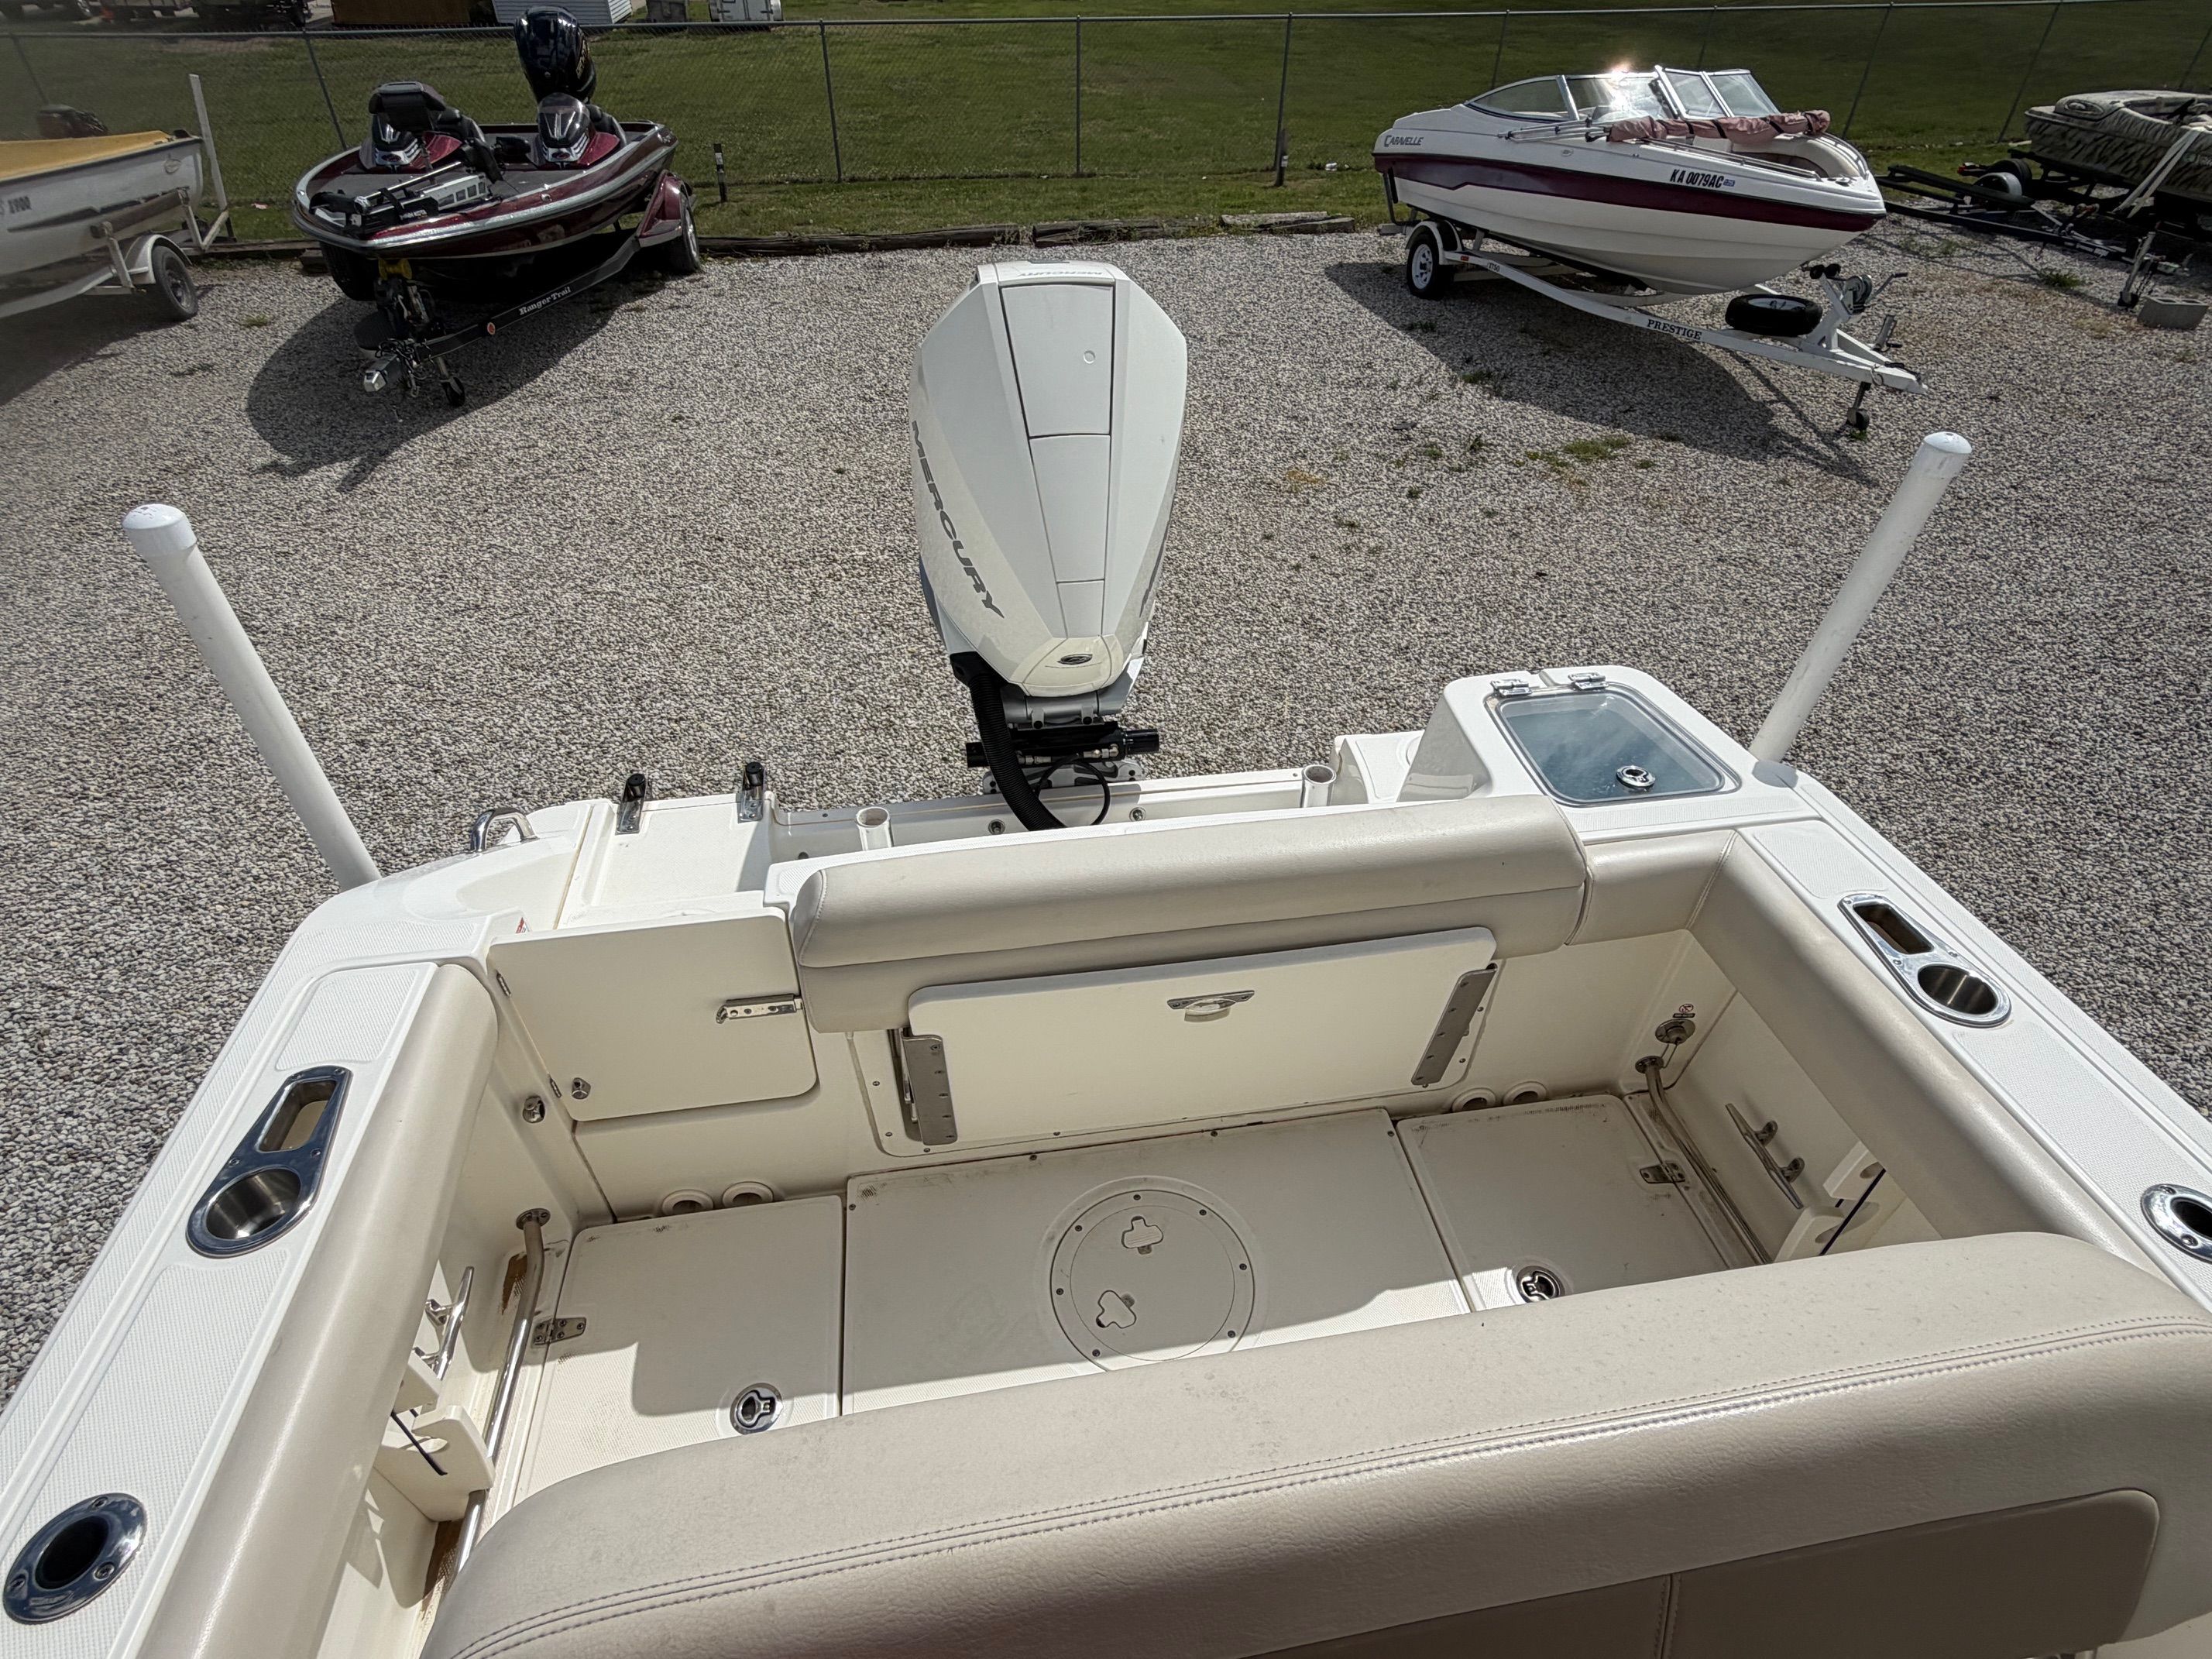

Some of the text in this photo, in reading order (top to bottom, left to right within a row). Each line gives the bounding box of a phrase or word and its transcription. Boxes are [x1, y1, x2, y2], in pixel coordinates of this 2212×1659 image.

[1384, 135, 1424, 147] CARAVELLE
[1670, 169, 1686, 184] KA
[1685, 172, 1724, 188] 0079AC
[519, 286, 572, 315] Ranger Trail
[1647, 319, 1702, 340] PRESTIGE
[912, 420, 1005, 619] MERCURY
